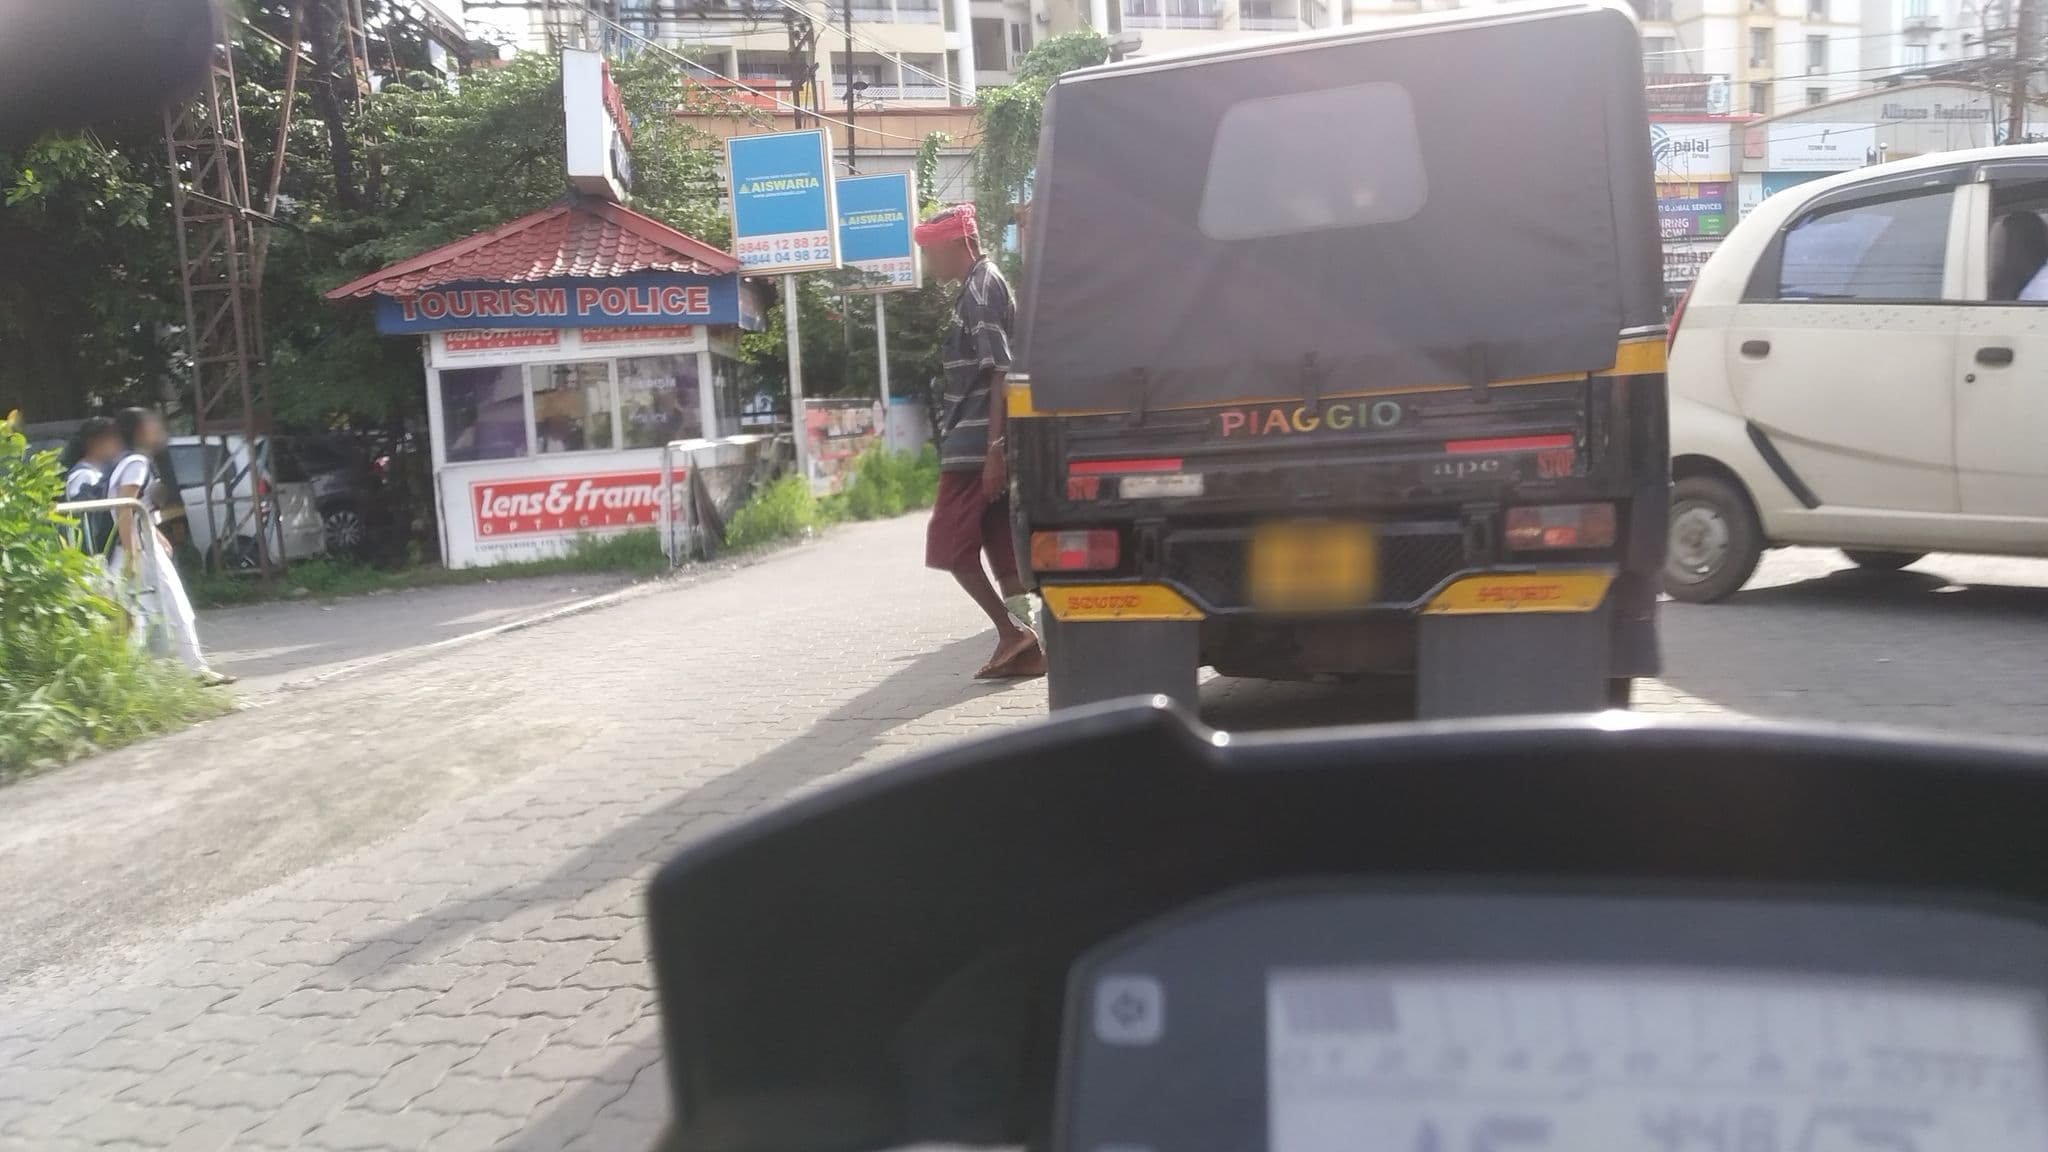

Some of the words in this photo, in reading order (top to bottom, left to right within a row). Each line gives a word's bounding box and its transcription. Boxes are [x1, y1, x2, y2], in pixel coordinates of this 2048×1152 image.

[751, 177, 820, 194] AISWARIA
[848, 212, 904, 226] AISWARIA
[775, 238, 789, 250] 12
[793, 237, 809, 249] 88
[814, 235, 828, 247] 22
[775, 252, 790, 263] 04
[794, 250, 810, 262] 98
[815, 249, 829, 260] 22
[898, 261, 911, 271] 22
[898, 272, 911, 282] 22
[396, 287, 567, 321] TOURISM
[576, 286, 710, 315] POLICE
[1219, 401, 1401, 437] PIAGGIO
[1432, 459, 1499, 479] ape
